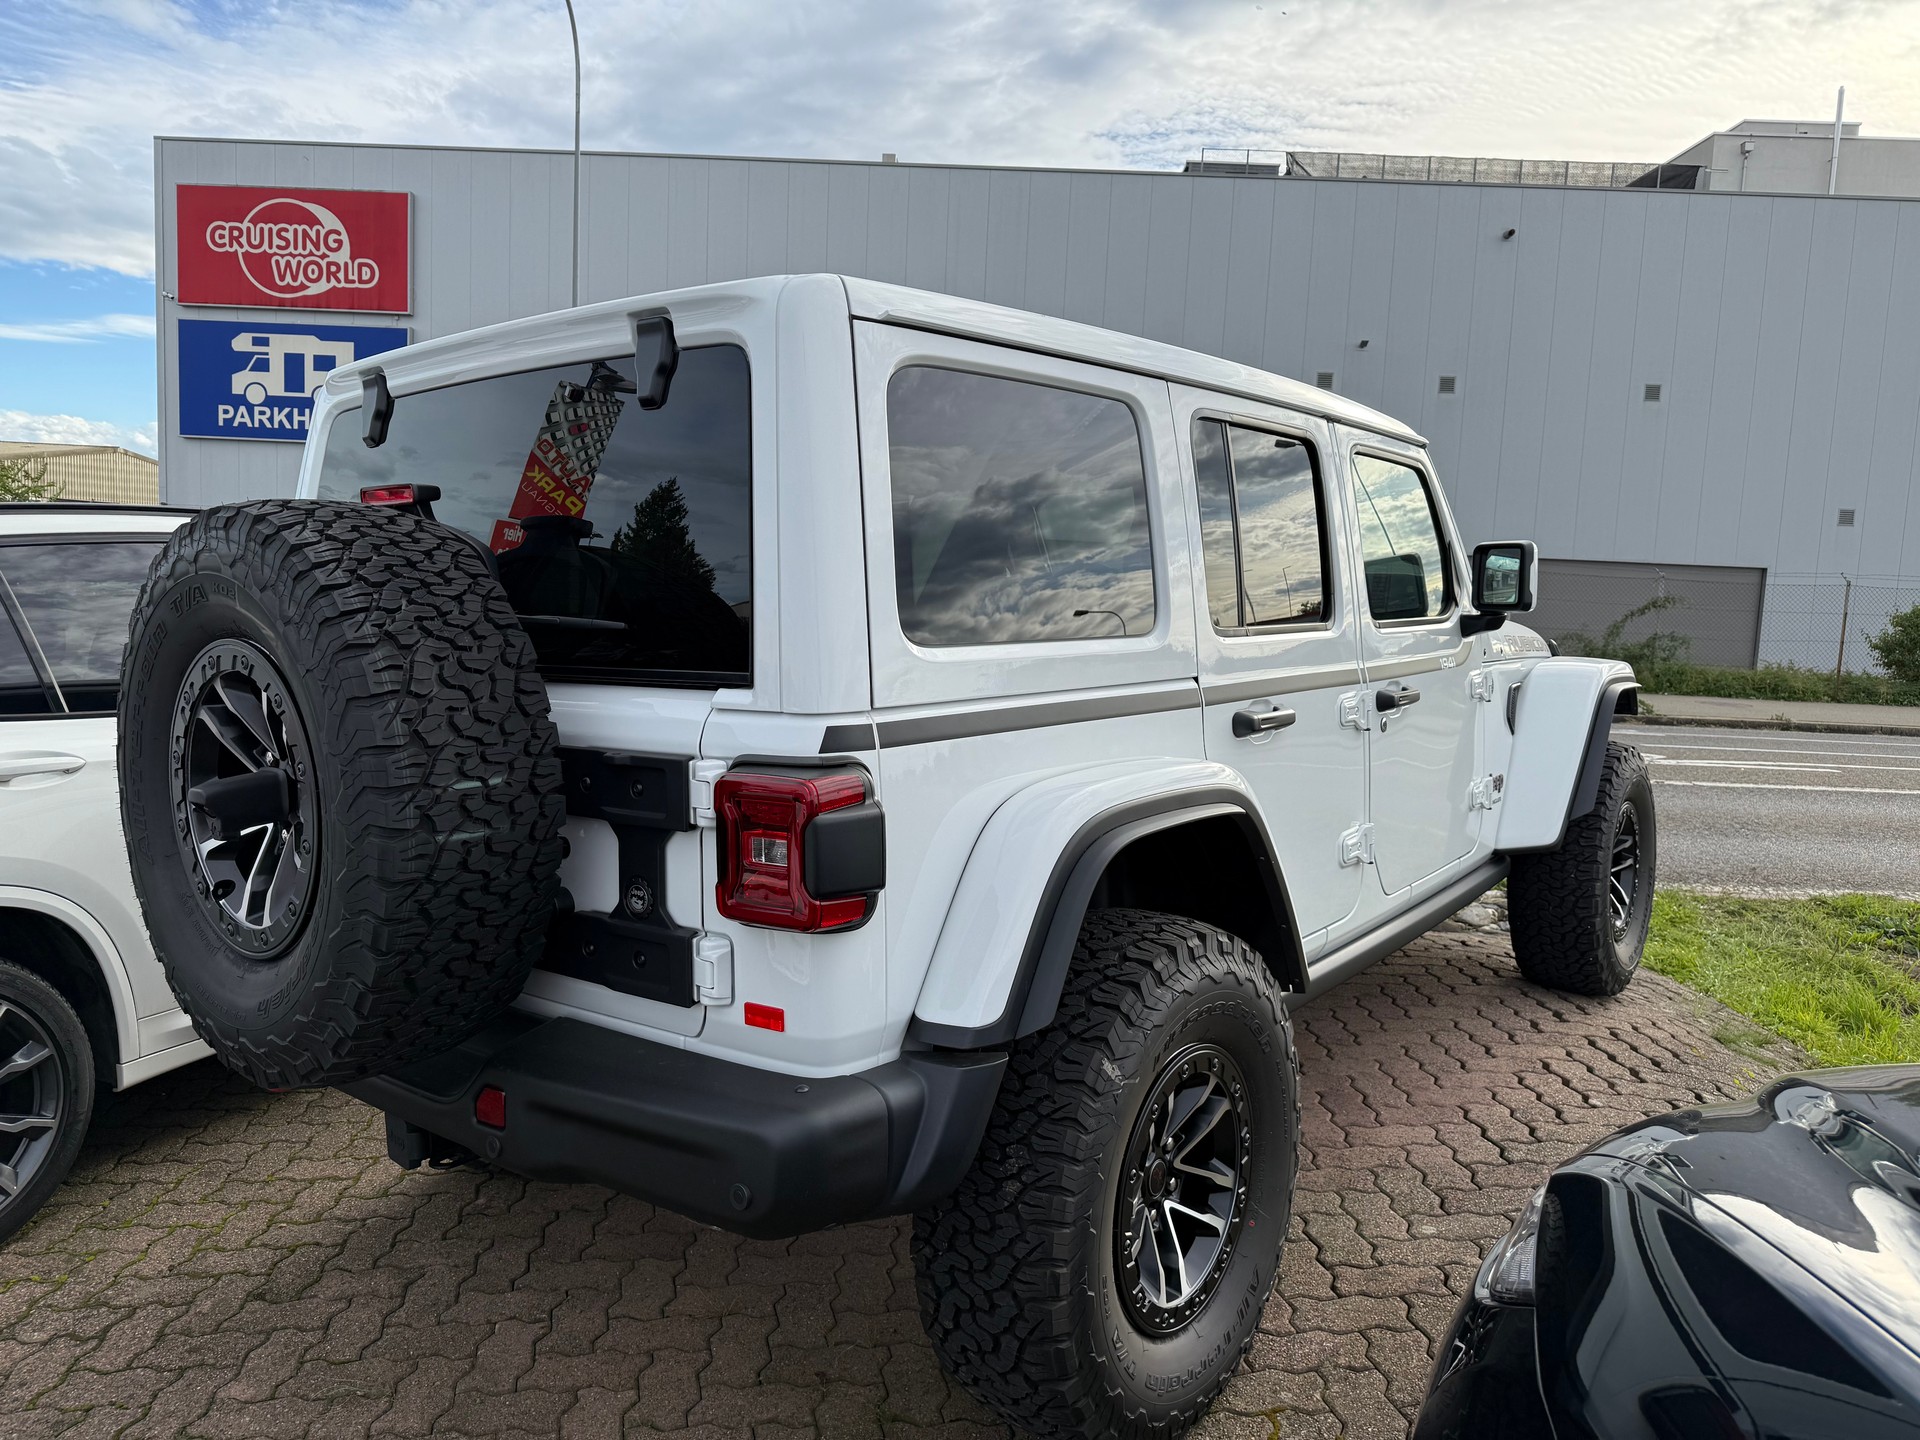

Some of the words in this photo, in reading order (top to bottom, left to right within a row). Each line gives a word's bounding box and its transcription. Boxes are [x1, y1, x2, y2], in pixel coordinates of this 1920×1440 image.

[208, 223, 345, 254] CRUISING
[274, 257, 377, 287] WORLD
[217, 404, 309, 430] PARKH
[169, 583, 209, 618] T/A
[1439, 657, 1457, 671] 1941
[630, 887, 645, 898] Jeep
